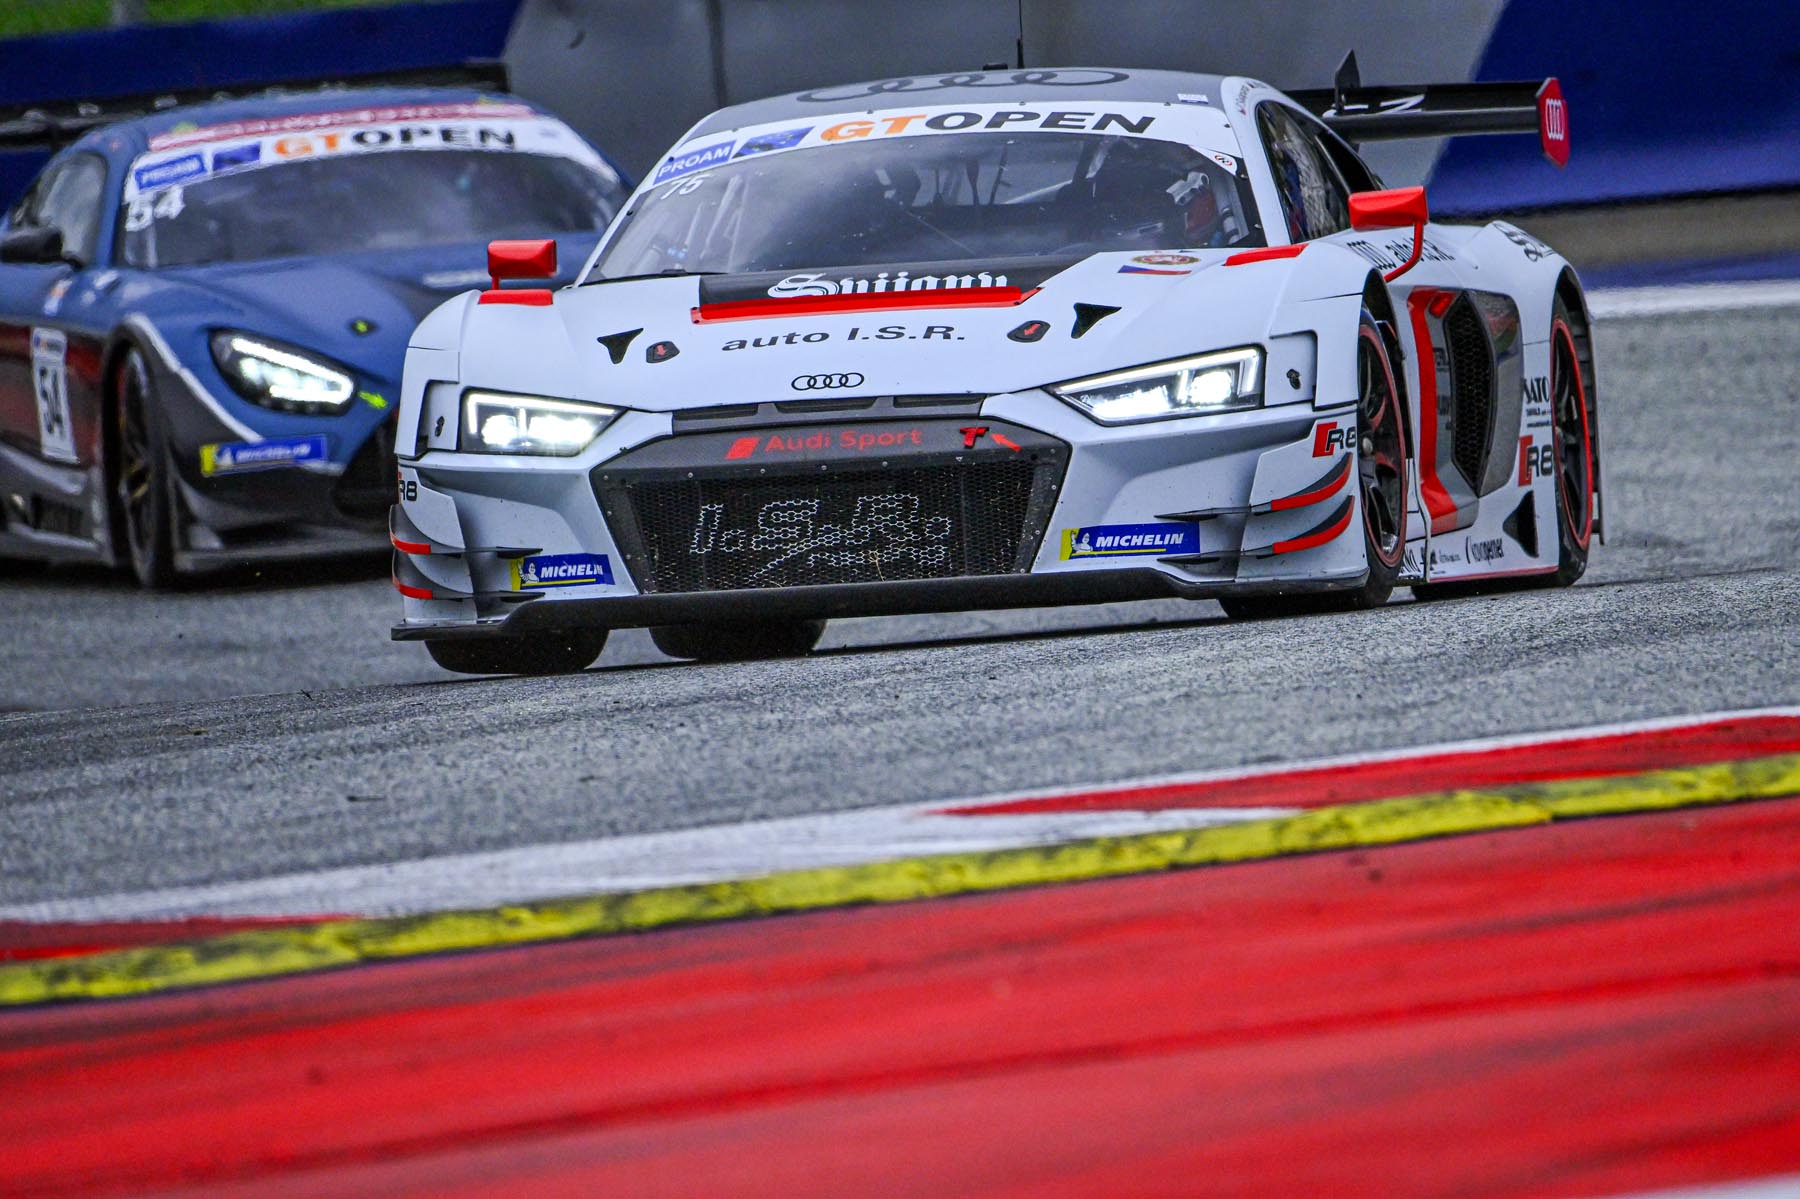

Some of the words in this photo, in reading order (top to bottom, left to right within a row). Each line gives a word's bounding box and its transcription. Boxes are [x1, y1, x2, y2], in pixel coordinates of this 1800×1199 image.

[657, 146, 731, 177] PROAM
[660, 174, 712, 200] 75
[721, 331, 830, 352] auto
[847, 325, 966, 341] I.S.R.
[765, 432, 830, 452] Audi
[839, 428, 923, 450] Sport
[1325, 426, 1357, 452] R8
[1526, 444, 1553, 478] R8
[1095, 532, 1184, 548] MICHELIN
[540, 563, 604, 579] MICHELIN
